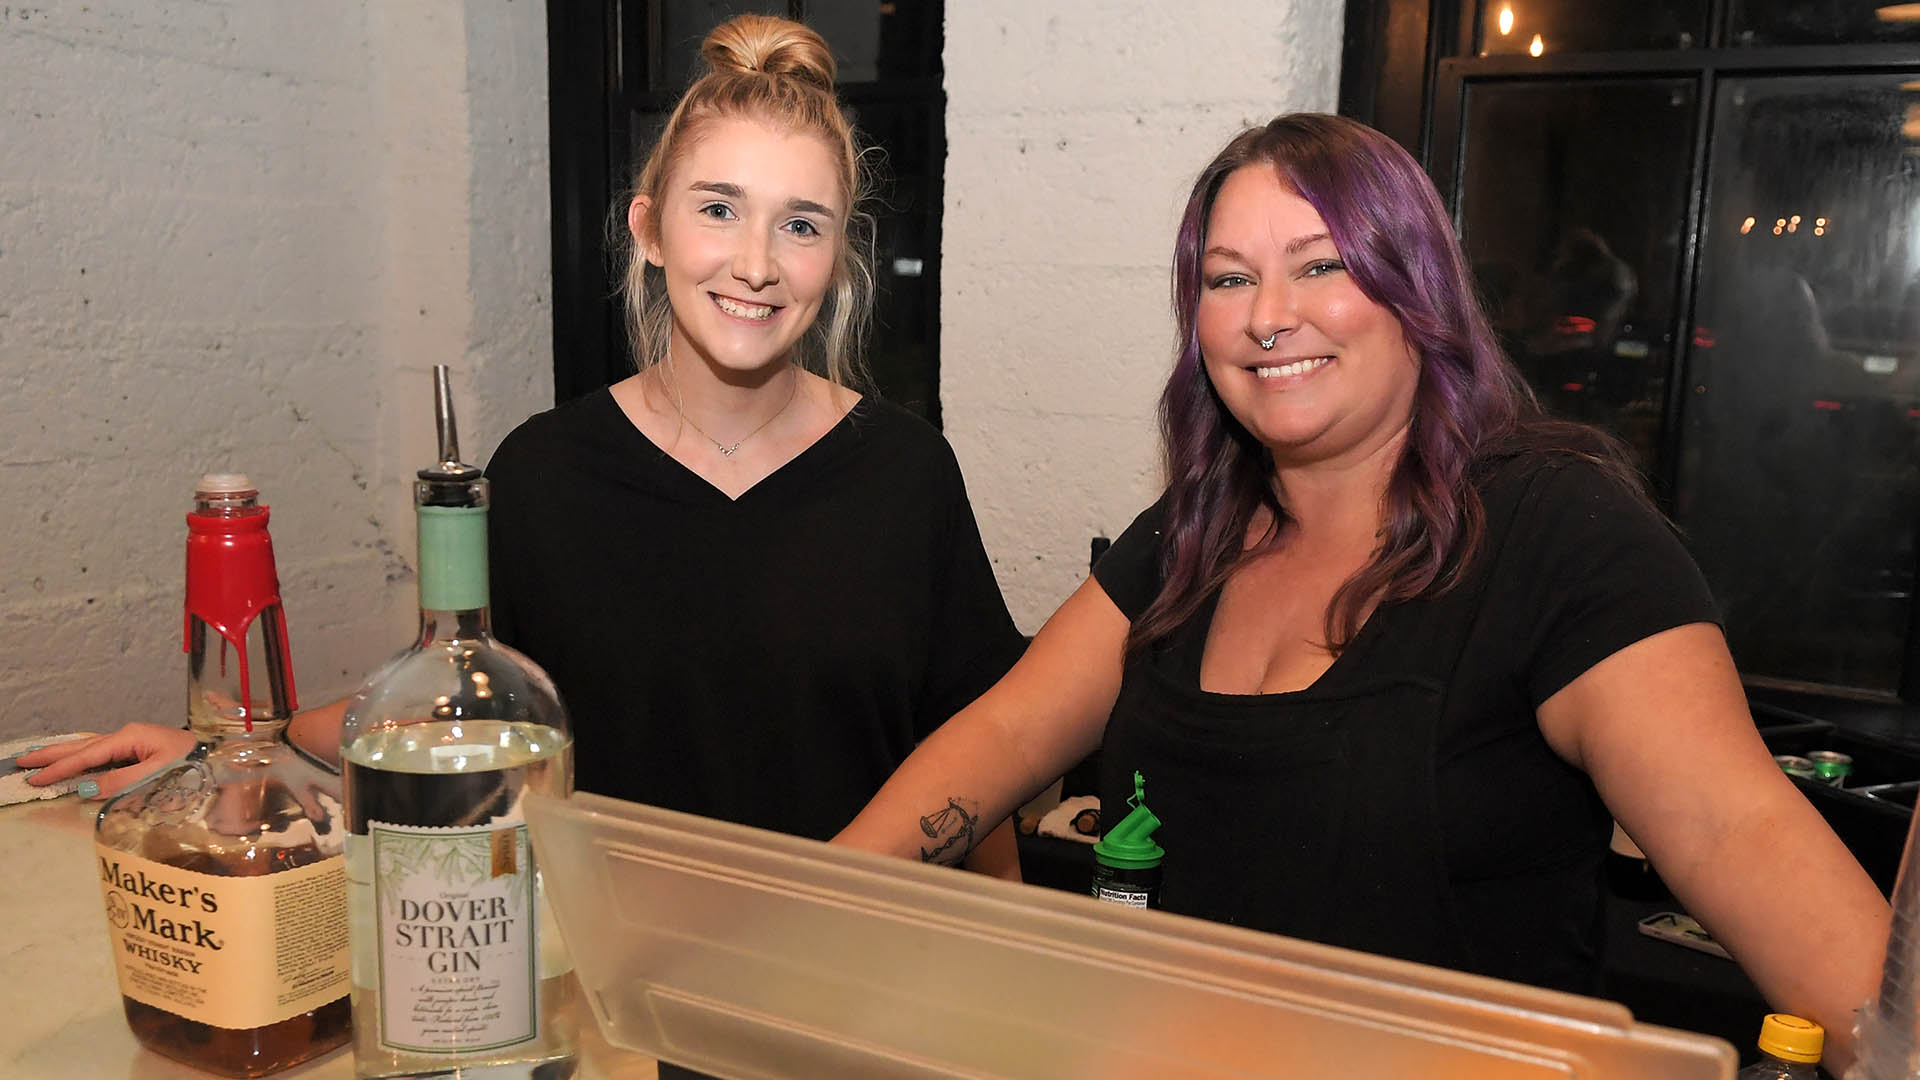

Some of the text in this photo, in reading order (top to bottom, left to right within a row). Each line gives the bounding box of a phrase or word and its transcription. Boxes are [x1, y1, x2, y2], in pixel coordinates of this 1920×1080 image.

[100, 855, 218, 913] Maker's
[1101, 889, 1127, 900] Nutrition
[400, 896, 508, 923] DOVER
[130, 903, 222, 951] Mark
[395, 919, 514, 949] STRAIT
[122, 938, 203, 975] WHISKY
[428, 949, 480, 974] GIN
